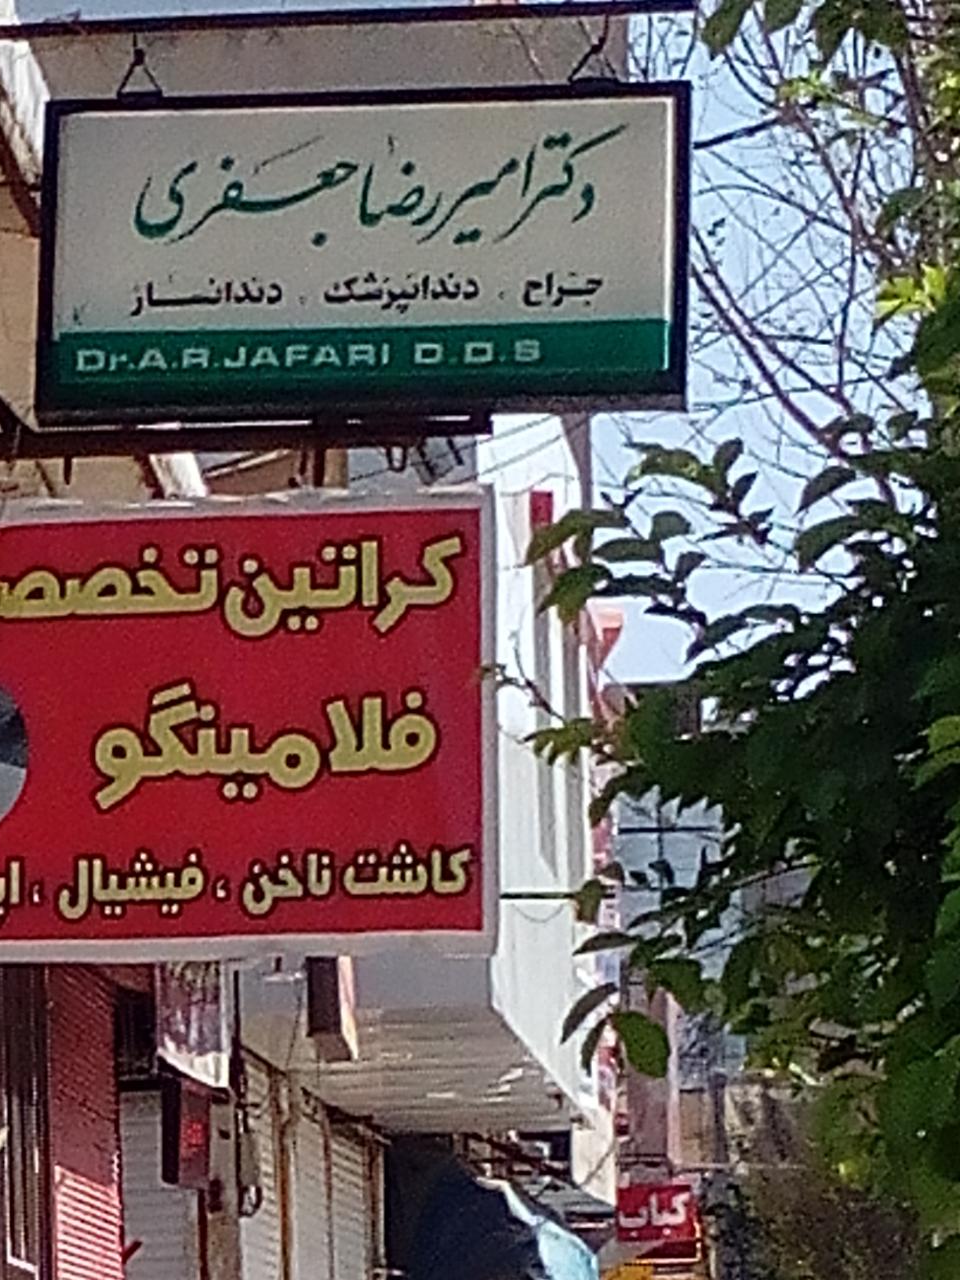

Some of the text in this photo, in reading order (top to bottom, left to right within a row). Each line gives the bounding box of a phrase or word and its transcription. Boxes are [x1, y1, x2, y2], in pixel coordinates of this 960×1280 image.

[132, 137, 360, 247] جعفری
[493, 122, 630, 243] دکتر
[130, 270, 605, 317] جراح دندانپزشک دندانساز
[225, 534, 463, 638] کراتین
[92, 682, 440, 812] فلامینگو
[342, 842, 473, 899] کاشت
[619, 1192, 690, 1238] کباب
